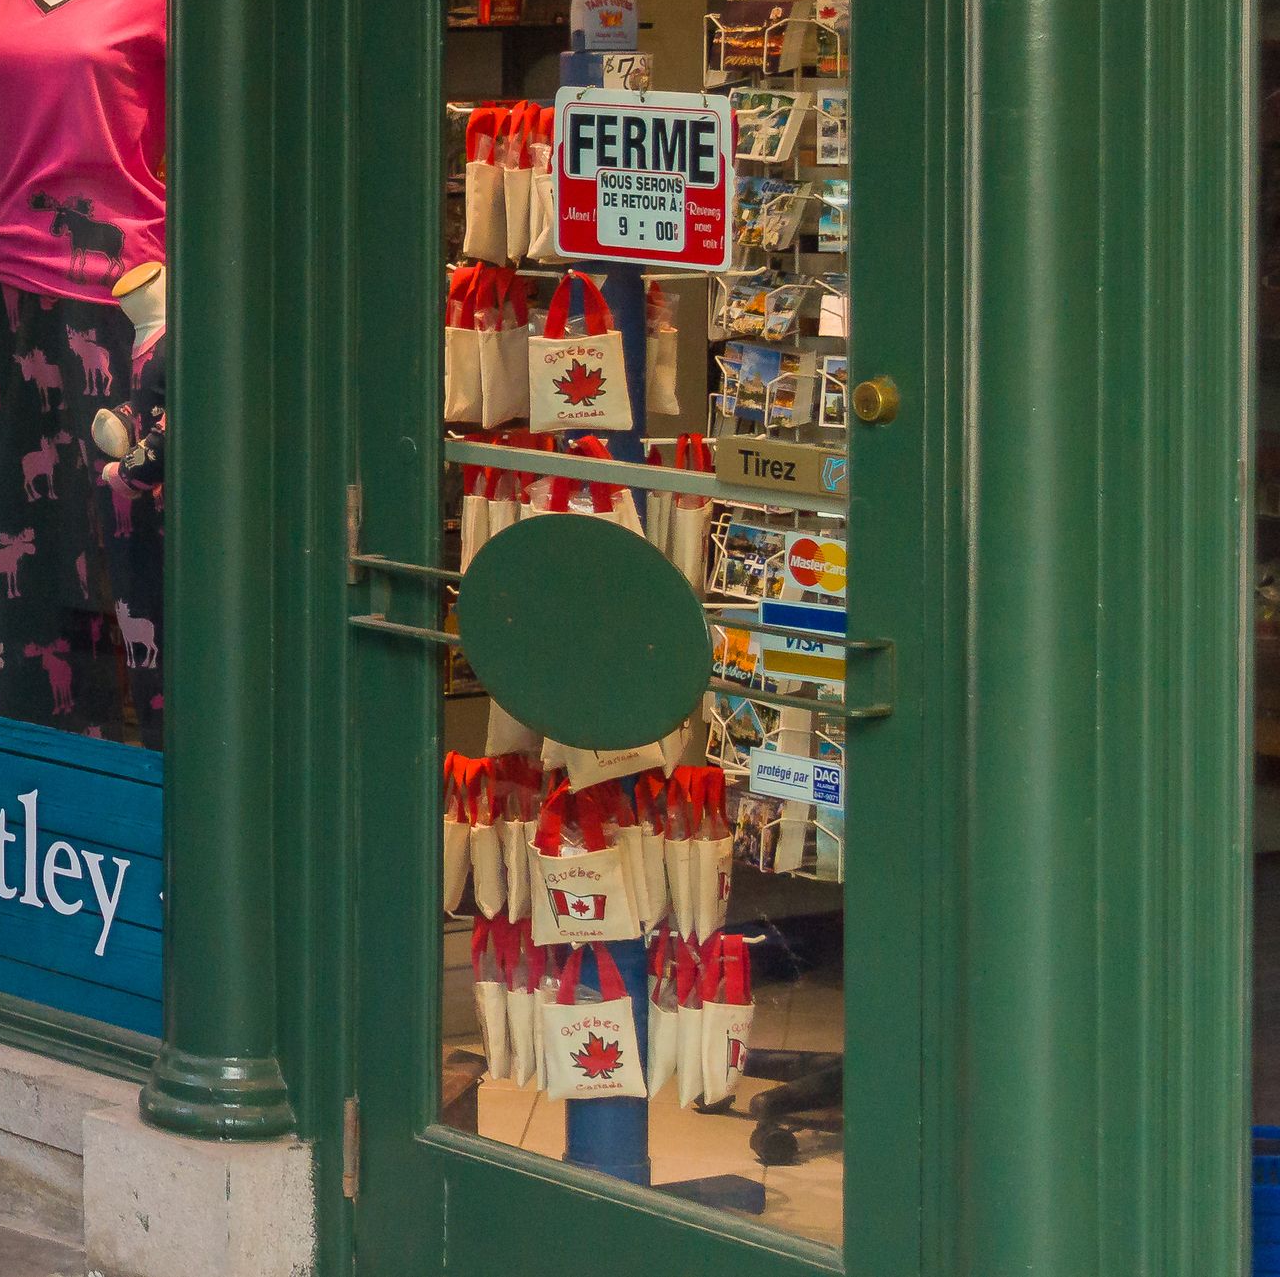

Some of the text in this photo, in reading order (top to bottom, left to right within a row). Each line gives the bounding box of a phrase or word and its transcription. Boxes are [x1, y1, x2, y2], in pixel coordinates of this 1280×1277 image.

[570, 113, 716, 184] FERMÉ
[601, 174, 683, 194] NOUS SERONS
[603, 192, 618, 207] DE
[621, 193, 666, 211] RETOUR
[685, 201, 721, 221] Revenez
[562, 206, 591, 221] Merci
[694, 223, 712, 233] nous
[702, 238, 718, 250] voir
[544, 346, 604, 365] Québec
[557, 408, 606, 419] Canada
[738, 449, 797, 482] Tirez
[757, 764, 810, 784] protégé par
[814, 767, 839, 785] DAG
[547, 867, 602, 885] Québec
[560, 1016, 621, 1038] Québec
